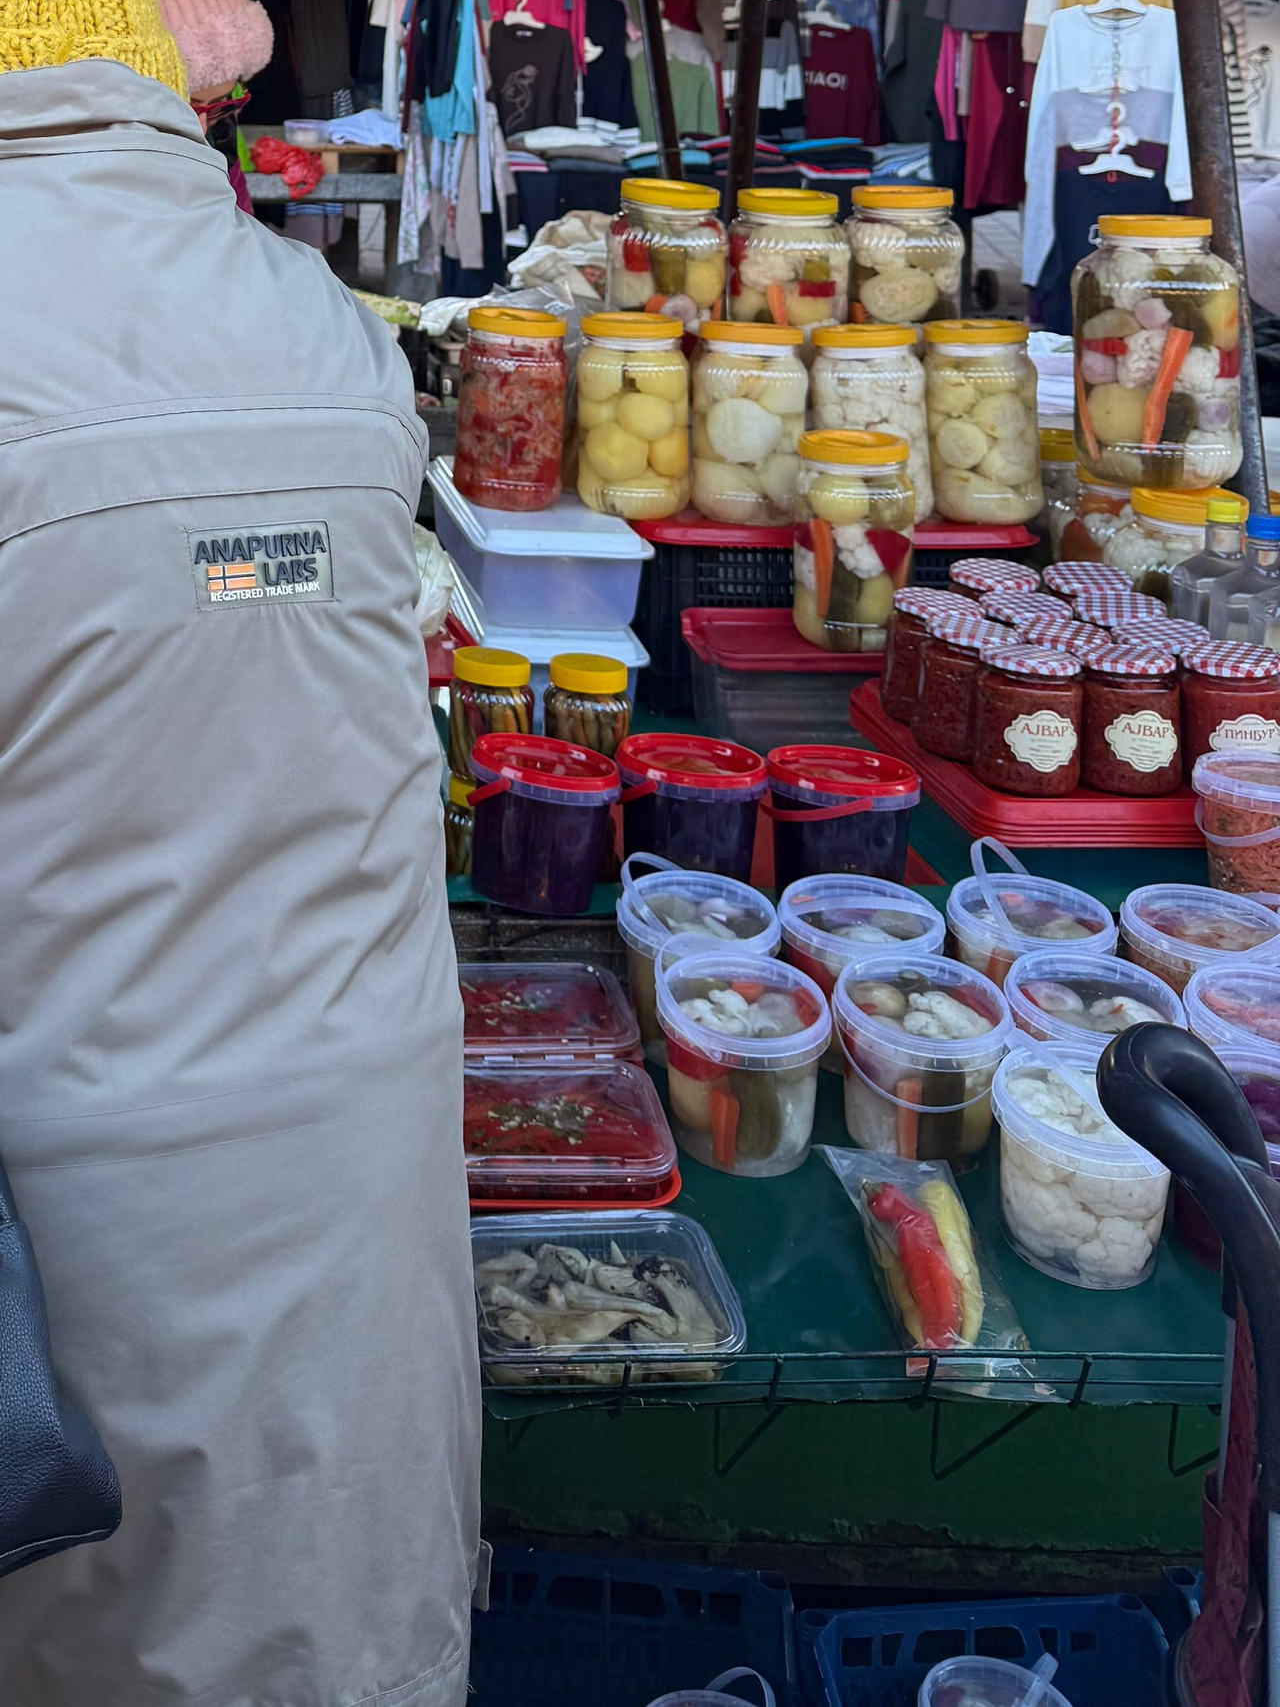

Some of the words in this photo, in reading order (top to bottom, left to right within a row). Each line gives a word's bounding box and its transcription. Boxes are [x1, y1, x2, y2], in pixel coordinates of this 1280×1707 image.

[195, 530, 327, 564] ANAPURNA
[262, 557, 319, 586] LABS
[210, 587, 264, 603] REGISTERED
[264, 584, 294, 598] TRADE
[295, 580, 321, 593] MARK
[1021, 722, 1069, 738] АЈВАР
[1121, 722, 1170, 739] АЈВАР
